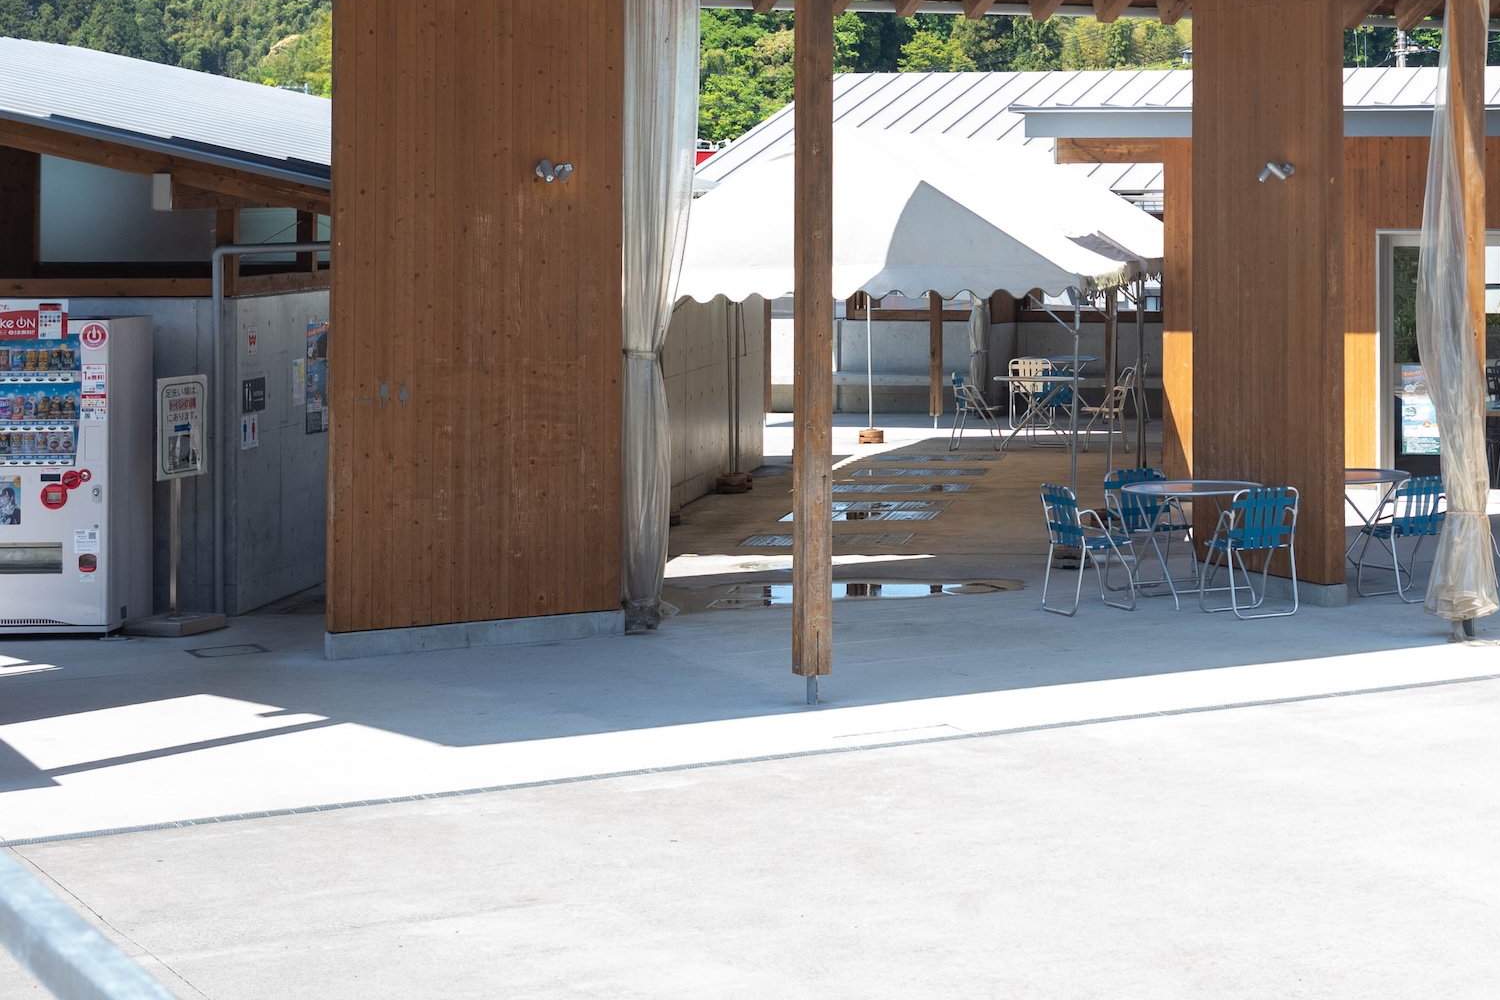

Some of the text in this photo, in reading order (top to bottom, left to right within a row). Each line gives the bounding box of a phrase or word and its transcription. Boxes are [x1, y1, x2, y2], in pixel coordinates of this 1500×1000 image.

[16, 316, 36, 328] ON
[165, 386, 199, 399] 足洗い場は、
[167, 412, 198, 423] にあります。
